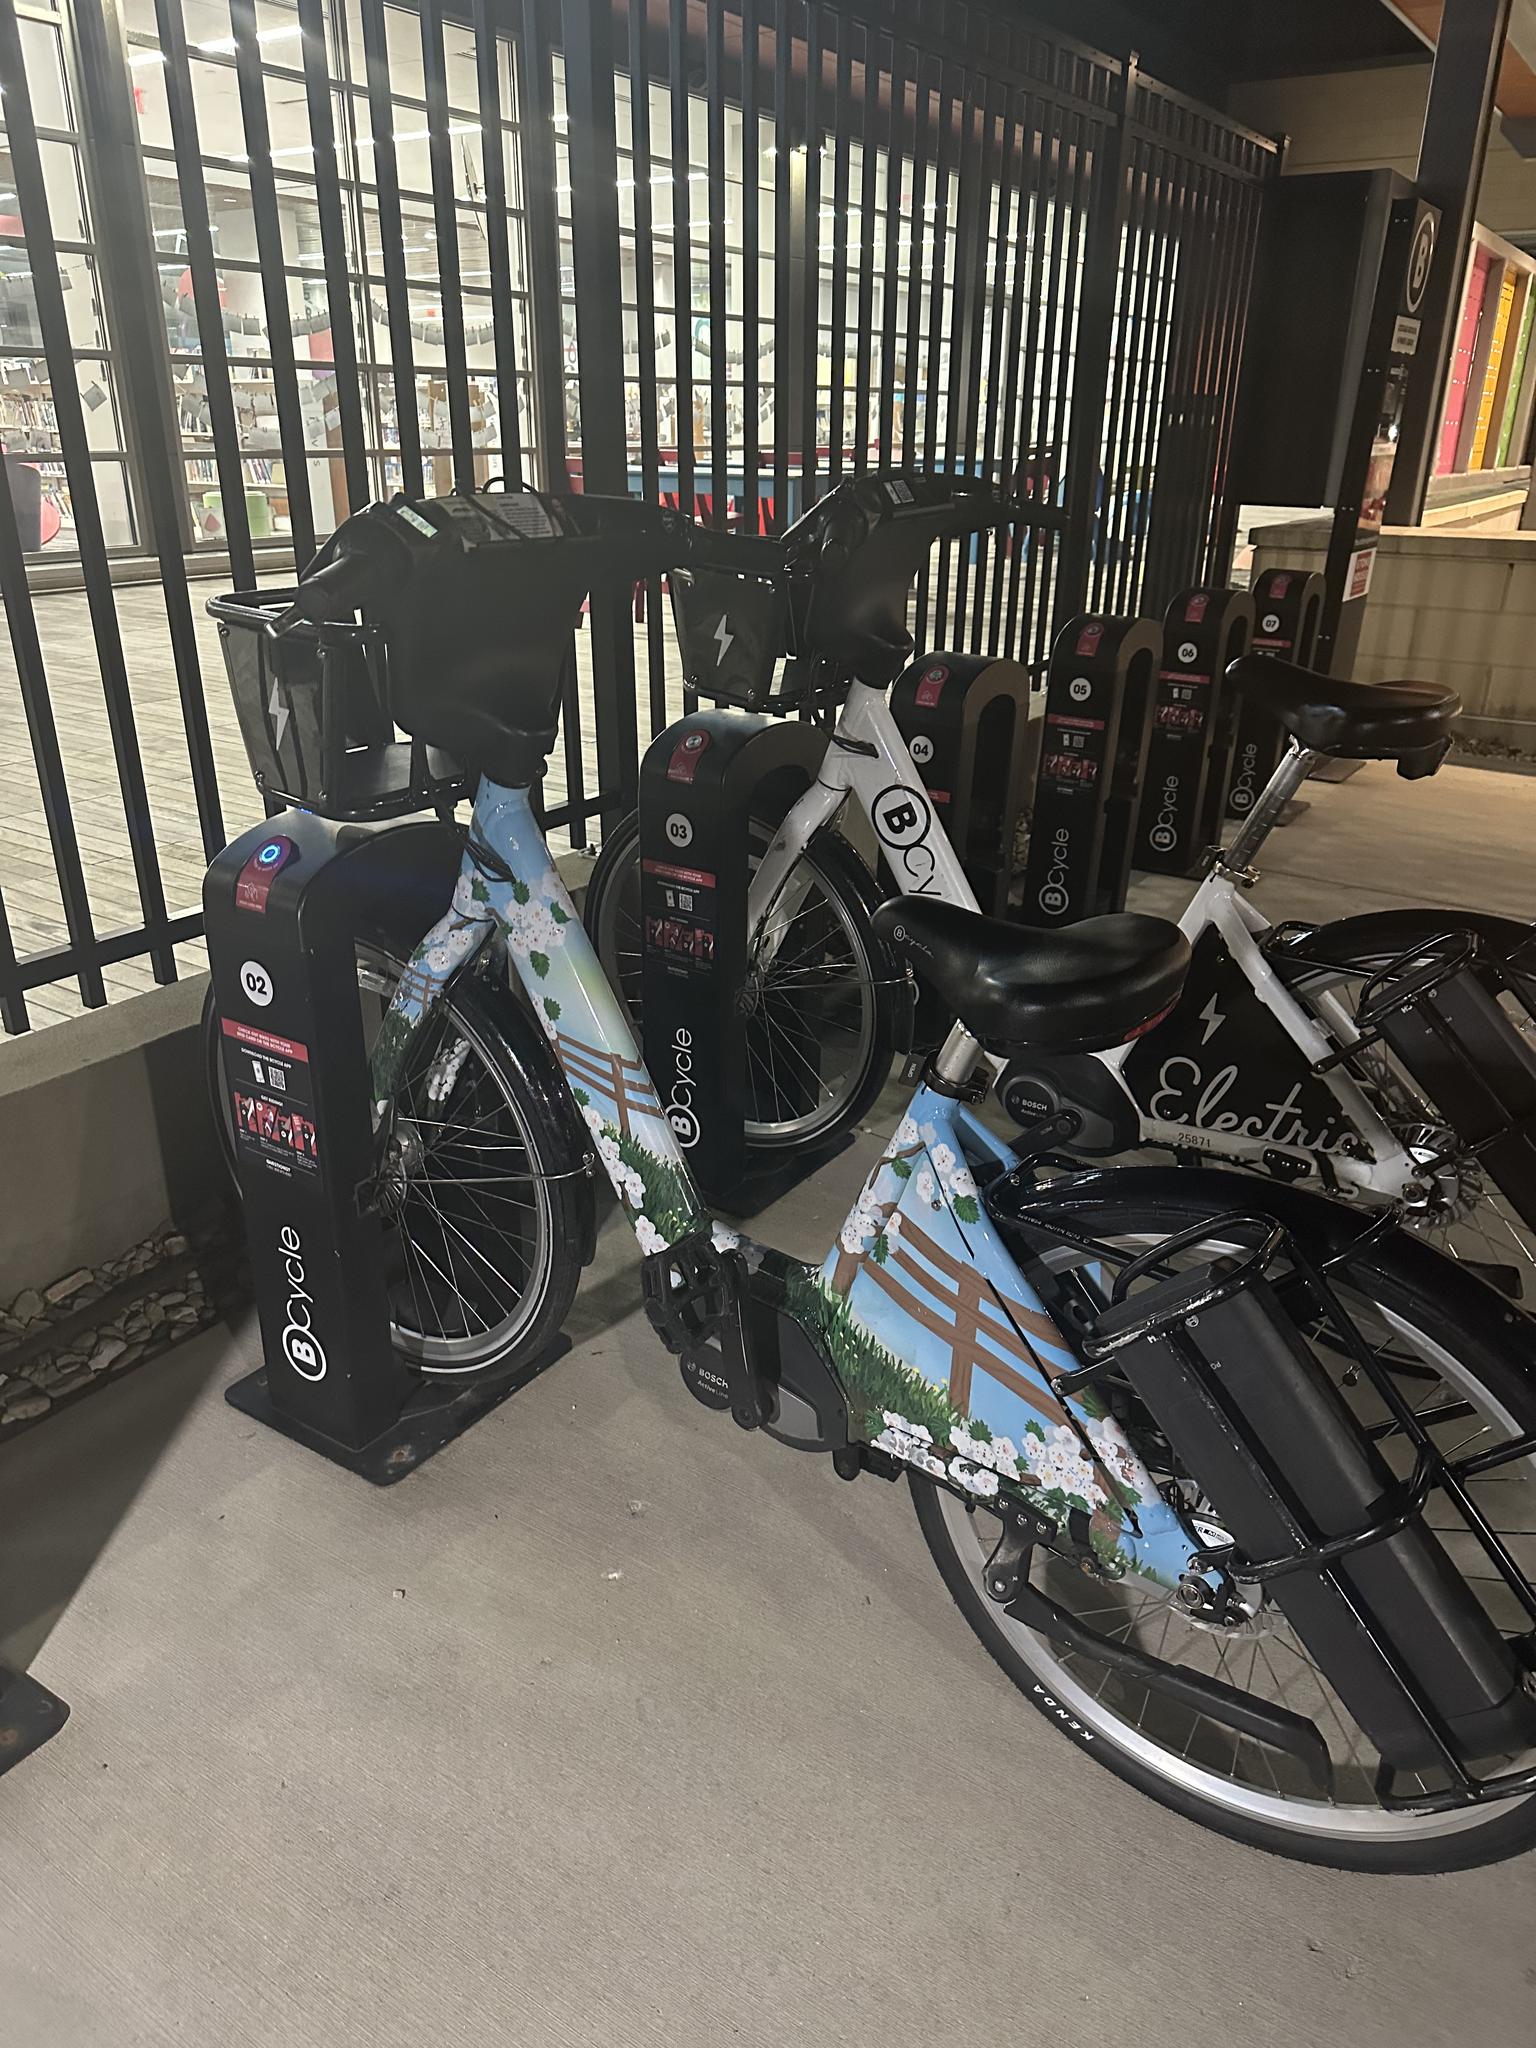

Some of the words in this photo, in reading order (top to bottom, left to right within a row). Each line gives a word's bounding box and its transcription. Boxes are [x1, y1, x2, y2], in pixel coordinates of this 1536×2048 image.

[1265, 620, 1277, 628] 07
[1181, 648, 1194, 658] 06
[1073, 684, 1087, 695] 05
[913, 743, 929, 756] 04
[1149, 775, 1179, 852] BCycle
[670, 822, 688, 840] 03
[1038, 827, 1070, 916] BCycle
[246, 972, 268, 996] 02
[665, 1027, 701, 1148] BCycle
[1021, 1099, 1048, 1111] BOSCH
[1150, 1057, 1358, 1155] Electric
[1178, 1132, 1211, 1147] 25871
[278, 1226, 327, 1382] BCycle
[699, 1368, 729, 1389] BOSCH
[1033, 1684, 1096, 1741] KENDA
